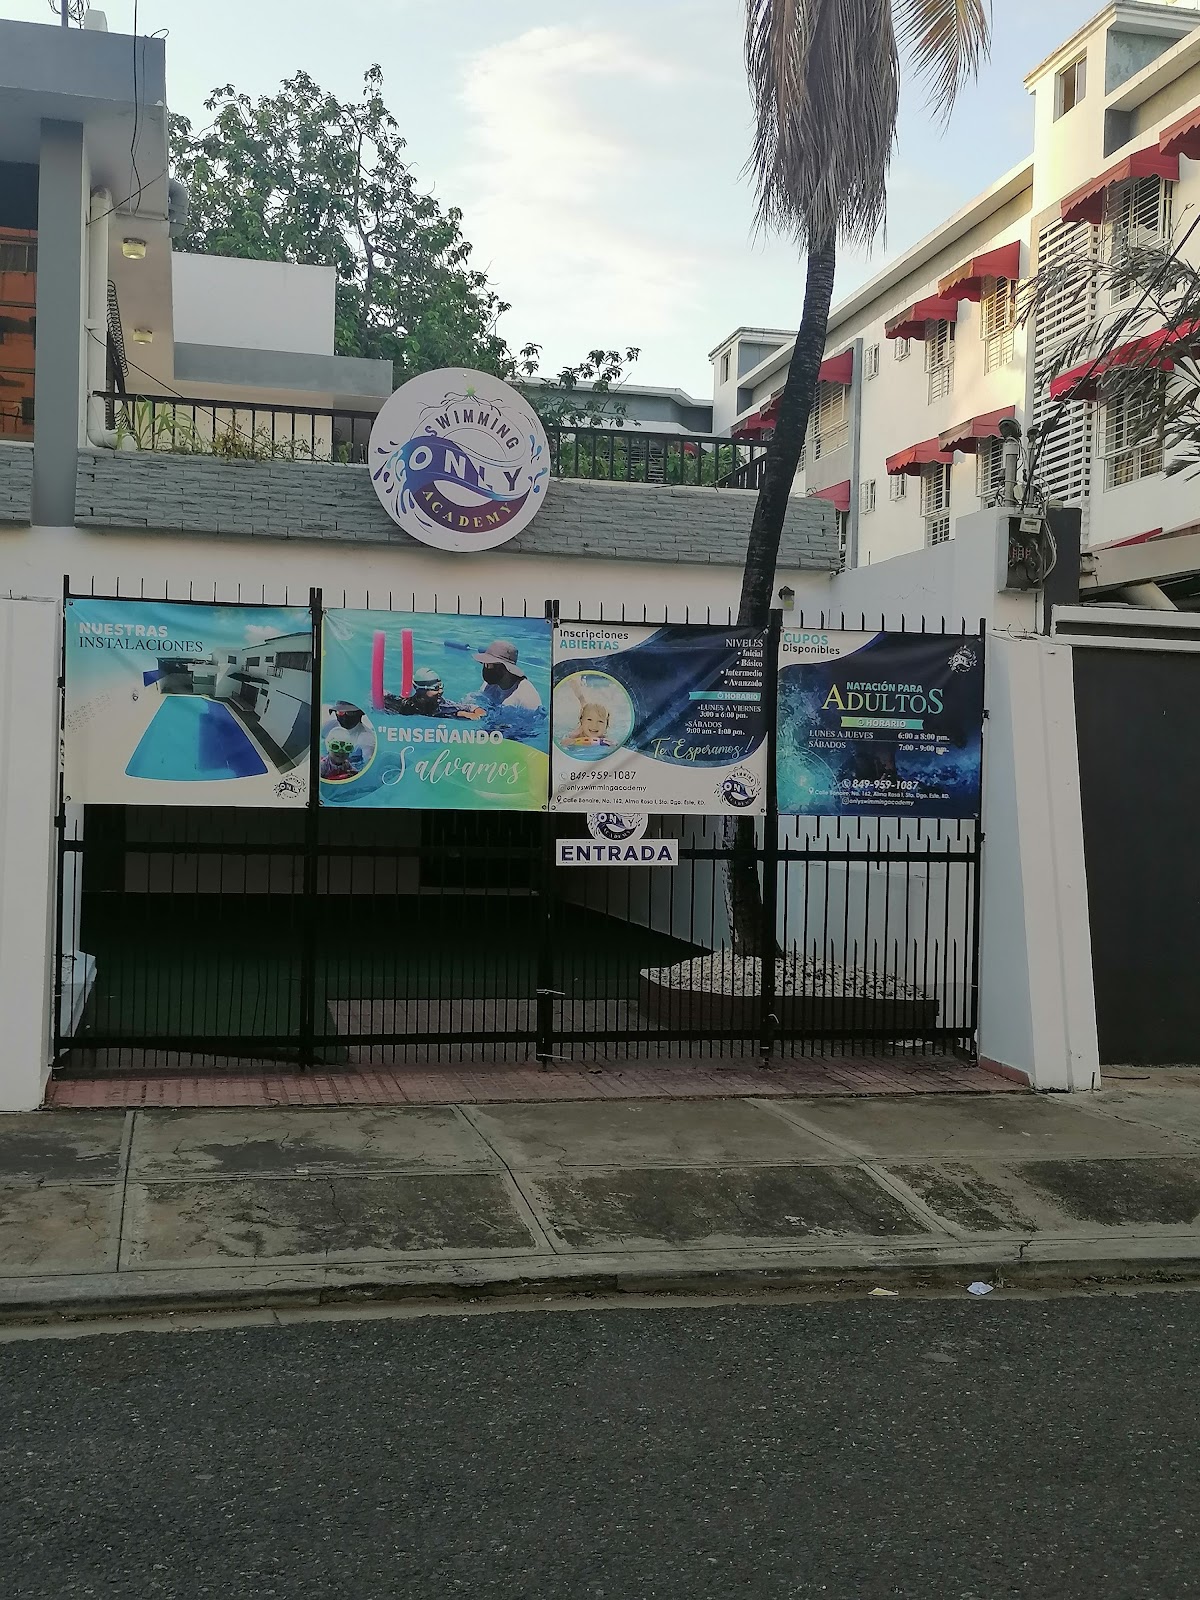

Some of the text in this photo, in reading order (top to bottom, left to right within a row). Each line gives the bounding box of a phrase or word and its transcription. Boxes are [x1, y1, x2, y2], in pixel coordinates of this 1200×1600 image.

[425, 409, 519, 450] SWIMMING
[409, 445, 523, 492] ONLY
[423, 490, 512, 528] ACADEMY
[79, 622, 168, 637] NUESTRAS
[560, 629, 629, 640] Inscripciones
[726, 639, 763, 648] NIVELES
[784, 633, 829, 645] CUPOS
[79, 636, 203, 653] INSTALACIONES
[560, 640, 619, 650] ABIERTAS
[783, 644, 840, 655] Disponibles
[743, 649, 763, 657] Inicial
[741, 659, 763, 667] Básico
[725, 669, 762, 677] Intermedio
[729, 679, 762, 687] Avanzado
[846, 681, 923, 692] NATACIÓN PARA
[725, 692, 758, 700] HORARIO
[822, 684, 944, 714] ADULTOS
[733, 705, 761, 713] VIERNES
[688, 720, 722, 728] SÁBADOS
[866, 719, 906, 728] HORARIO
[378, 725, 504, 744] "ENSEÑANDO
[809, 730, 874, 739] LUNES A JUEVES
[898, 732, 913, 740] 6:00
[651, 737, 671, 758] Te
[808, 740, 846, 749] SÁBADOS
[920, 744, 935, 752] 9:00
[382, 746, 527, 786] Salvamos
[570, 770, 636, 780] 849-959-1087
[852, 779, 919, 790] 849-959-1087
[561, 845, 673, 861] ENTRADA
